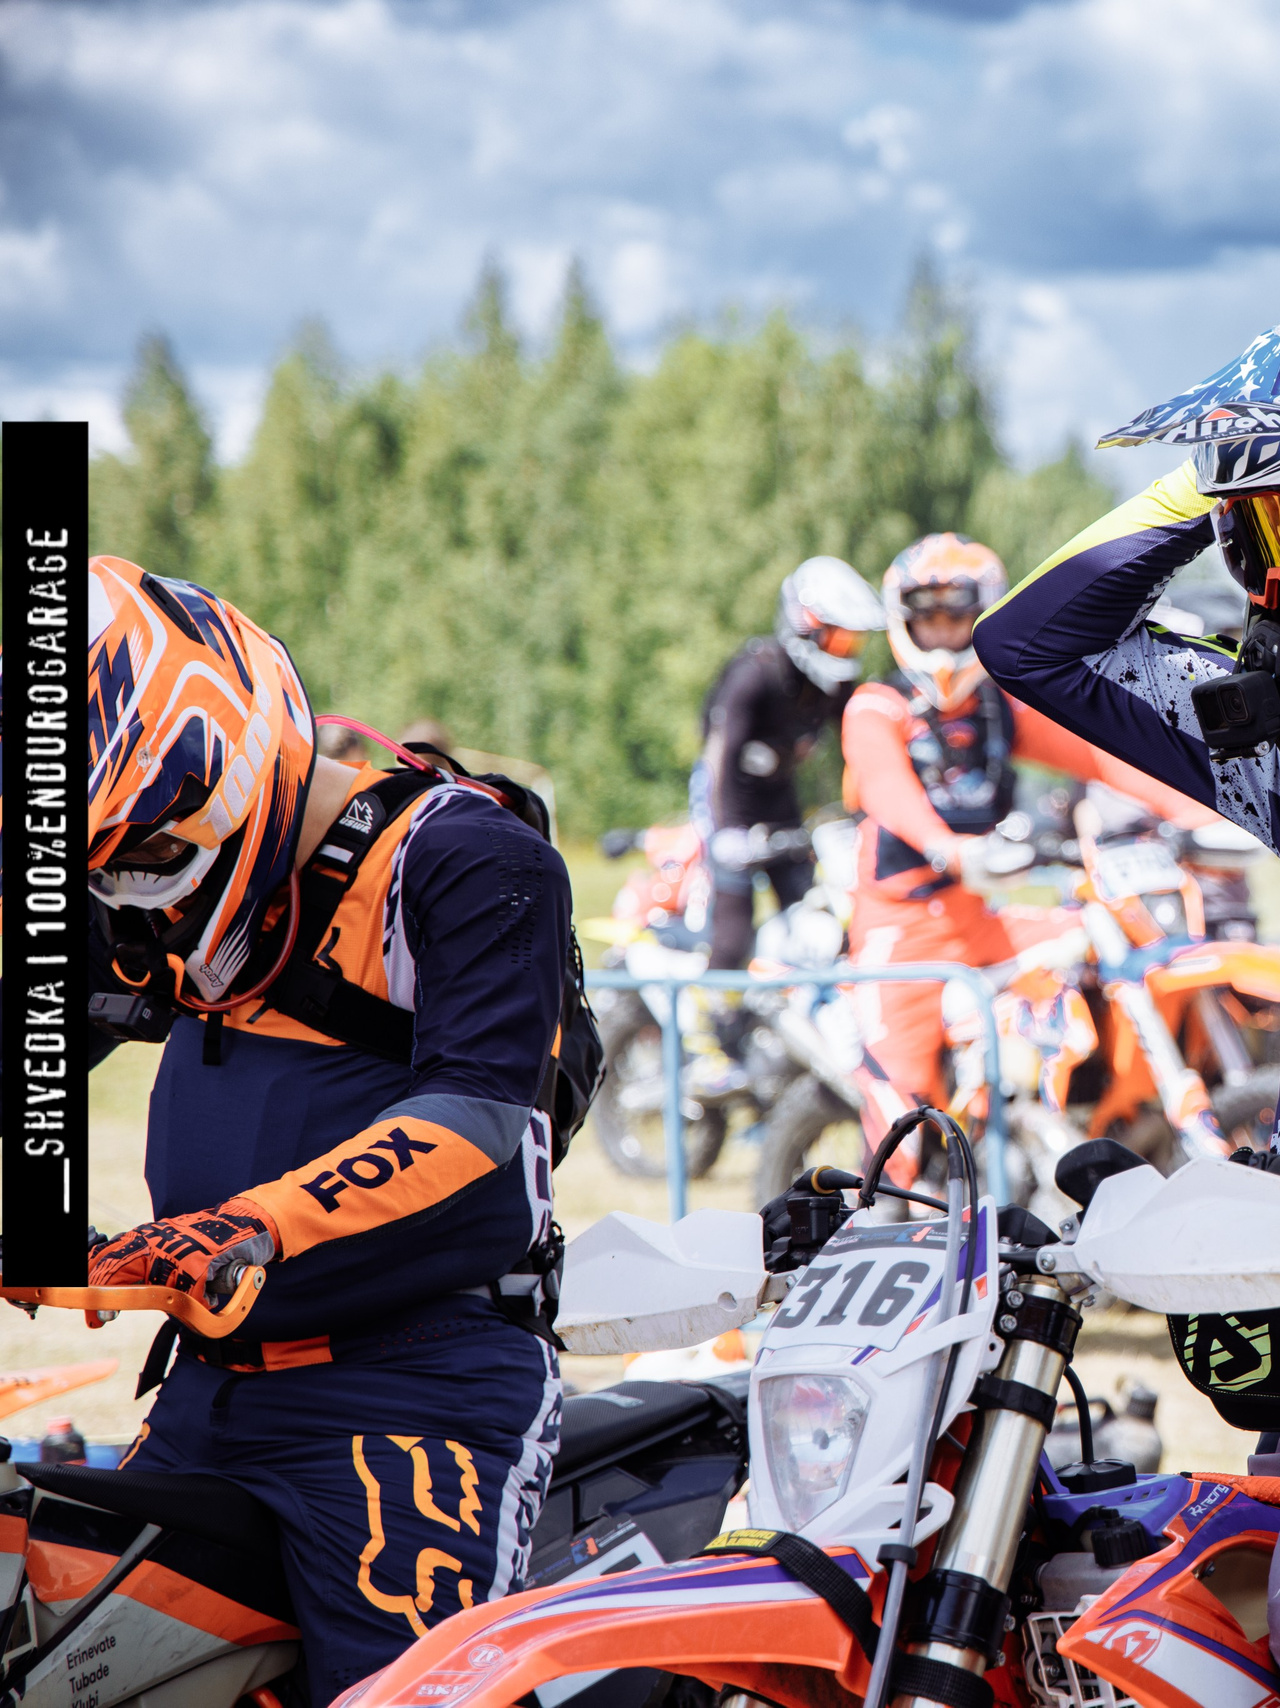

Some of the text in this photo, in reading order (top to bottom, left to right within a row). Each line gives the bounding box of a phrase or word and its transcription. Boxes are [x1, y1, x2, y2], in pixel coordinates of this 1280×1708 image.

[299, 1127, 438, 1214] FOX
[775, 1260, 931, 1330] 316
[66, 1635, 117, 1671] Erinevate
[69, 1663, 110, 1694] Tubade
